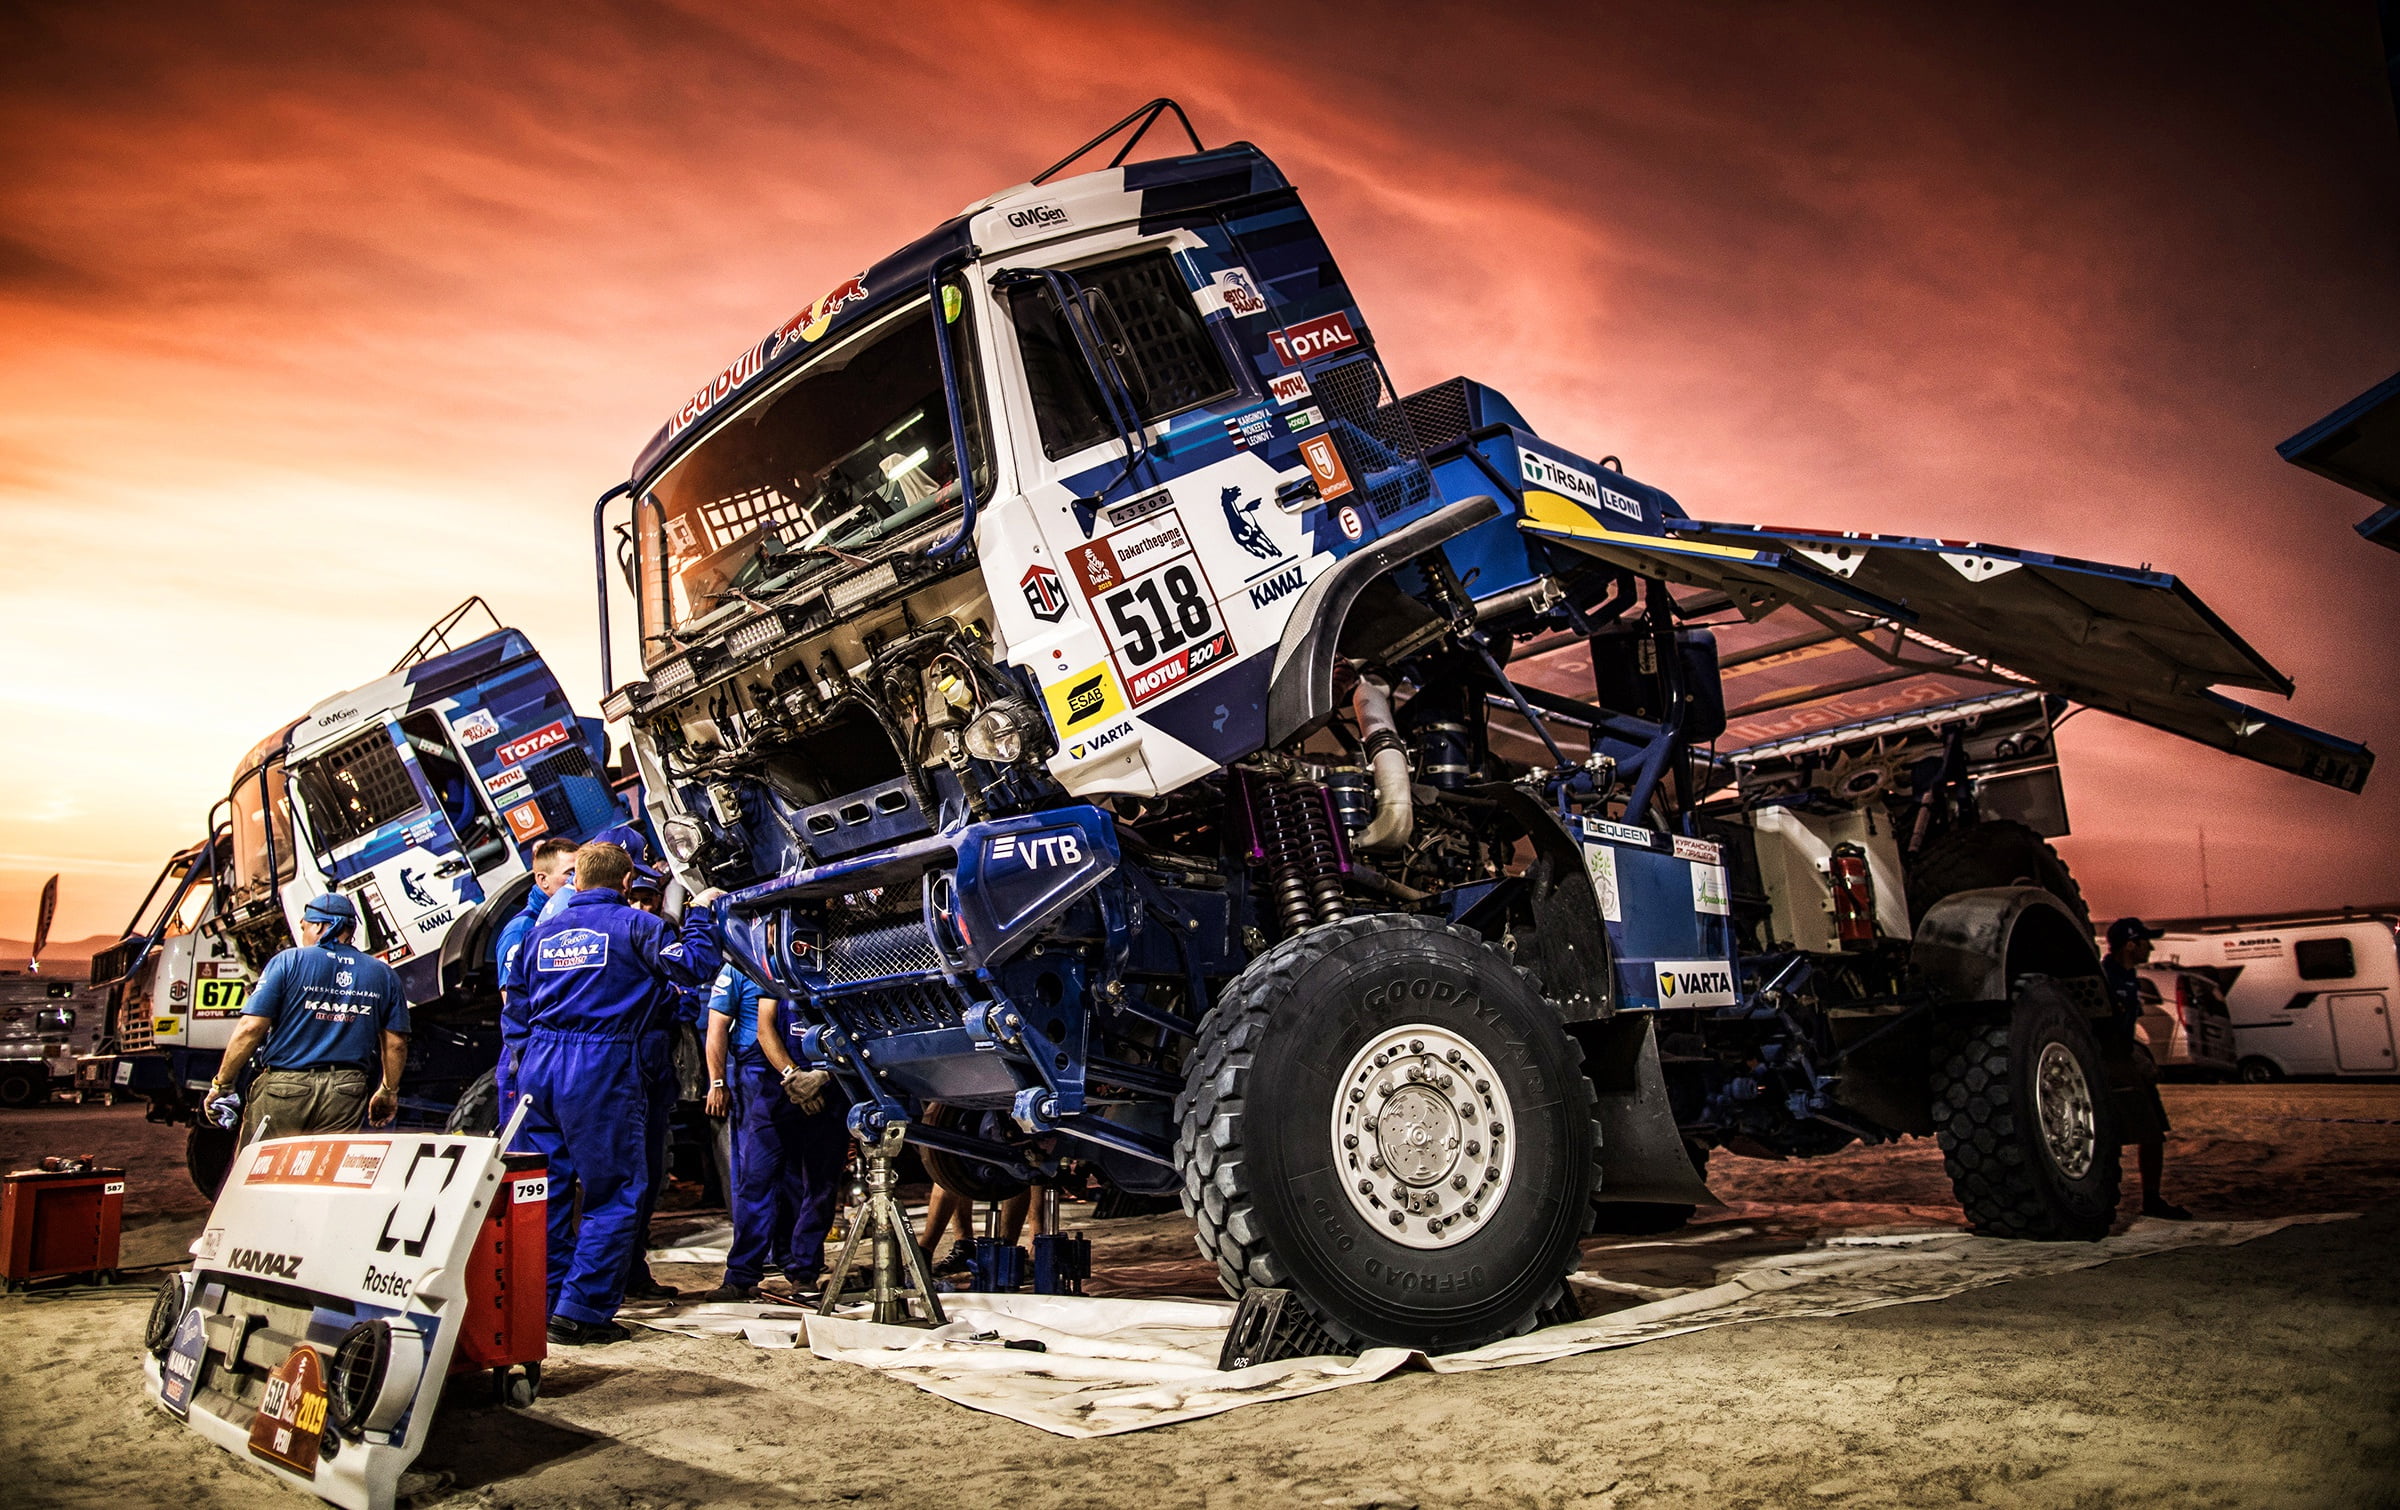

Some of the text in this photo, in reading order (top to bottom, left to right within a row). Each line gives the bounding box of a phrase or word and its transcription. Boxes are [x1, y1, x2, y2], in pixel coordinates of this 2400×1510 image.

[1008, 205, 1066, 228] GMGen
[1233, 298, 1264, 315] РАДИО
[1274, 324, 1352, 360] TOTAL
[1246, 430, 1270, 447] LEONOV
[1115, 495, 1168, 523] 43509
[1603, 490, 1641, 518] LEONI
[1343, 512, 1359, 534] E
[1117, 526, 1181, 562] Dakarthegame
[1170, 536, 1186, 551] .com
[1248, 564, 1308, 610] KAMAZ
[1105, 564, 1213, 668] 518
[1133, 634, 1226, 700] MOTUL 300V
[1068, 687, 1104, 712] ESAB
[318, 707, 359, 728] GMGen
[500, 729, 565, 761] TOTAL
[1086, 721, 1134, 751] VARTA
[1586, 819, 1648, 843] ICEQUEEN
[1018, 834, 1082, 870] VTB
[418, 909, 455, 934] KAMAZ
[337, 955, 355, 965] VTB
[542, 943, 600, 960] KAMAZ
[202, 981, 246, 1007] 677
[1677, 972, 1732, 994] VARTA
[304, 1000, 373, 1016] KAMAZ
[516, 1183, 545, 1198] 799
[228, 1248, 304, 1280] KAMAZ
[361, 1264, 412, 1298] Rostec
[168, 1350, 197, 1381] KAMAZ
[295, 1391, 328, 1436] 2019
